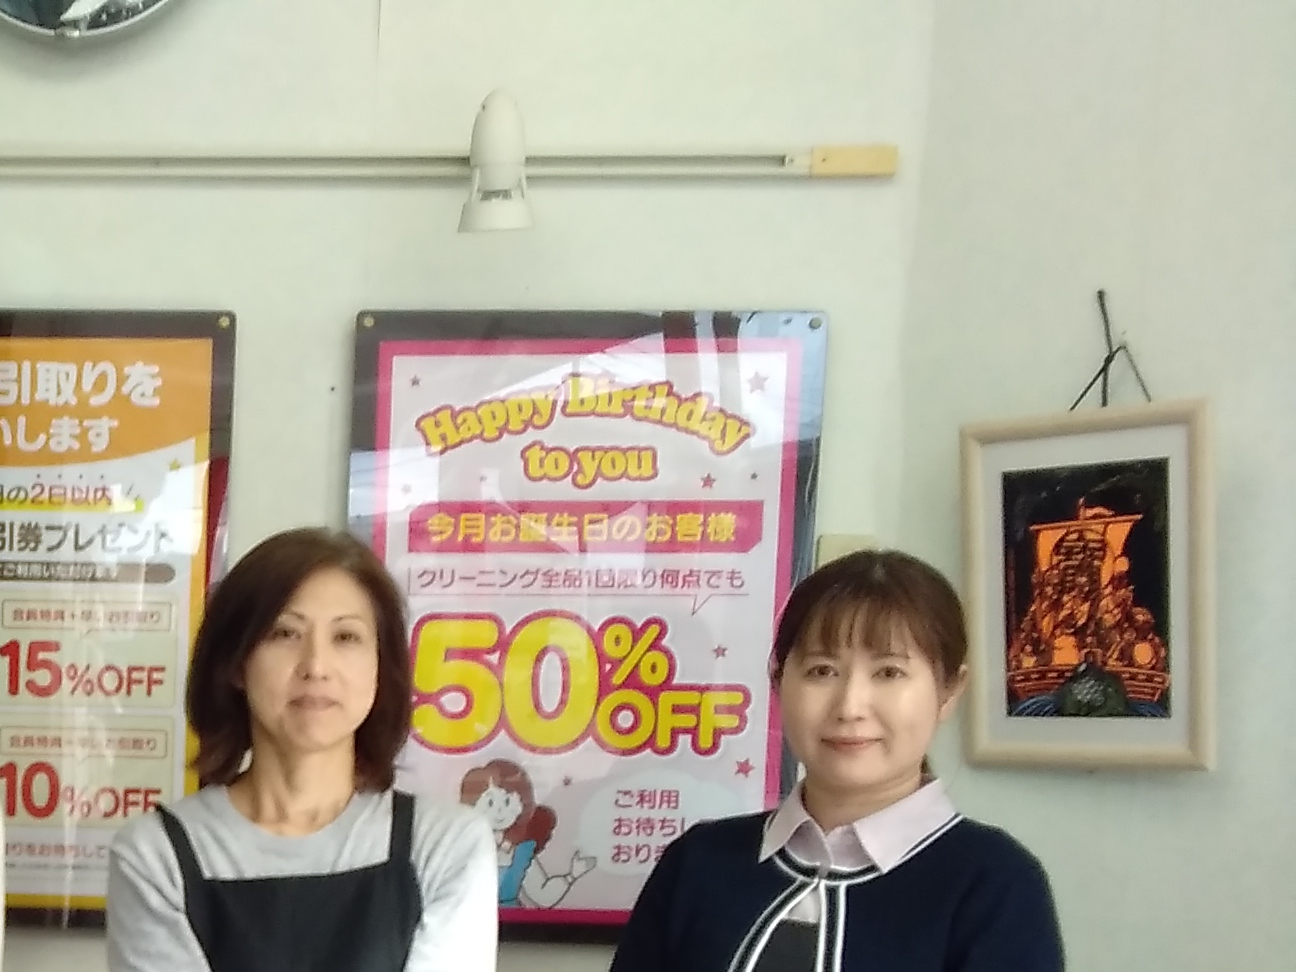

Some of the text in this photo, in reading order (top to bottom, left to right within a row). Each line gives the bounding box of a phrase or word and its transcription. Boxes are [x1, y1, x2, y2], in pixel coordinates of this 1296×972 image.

[415, 371, 755, 455] Happy Birthday
[522, 440, 659, 487] to you
[427, 511, 737, 544] 今月お誕生日のお客様
[410, 609, 751, 757] 50% OFF
[614, 788, 680, 810] ご利用
